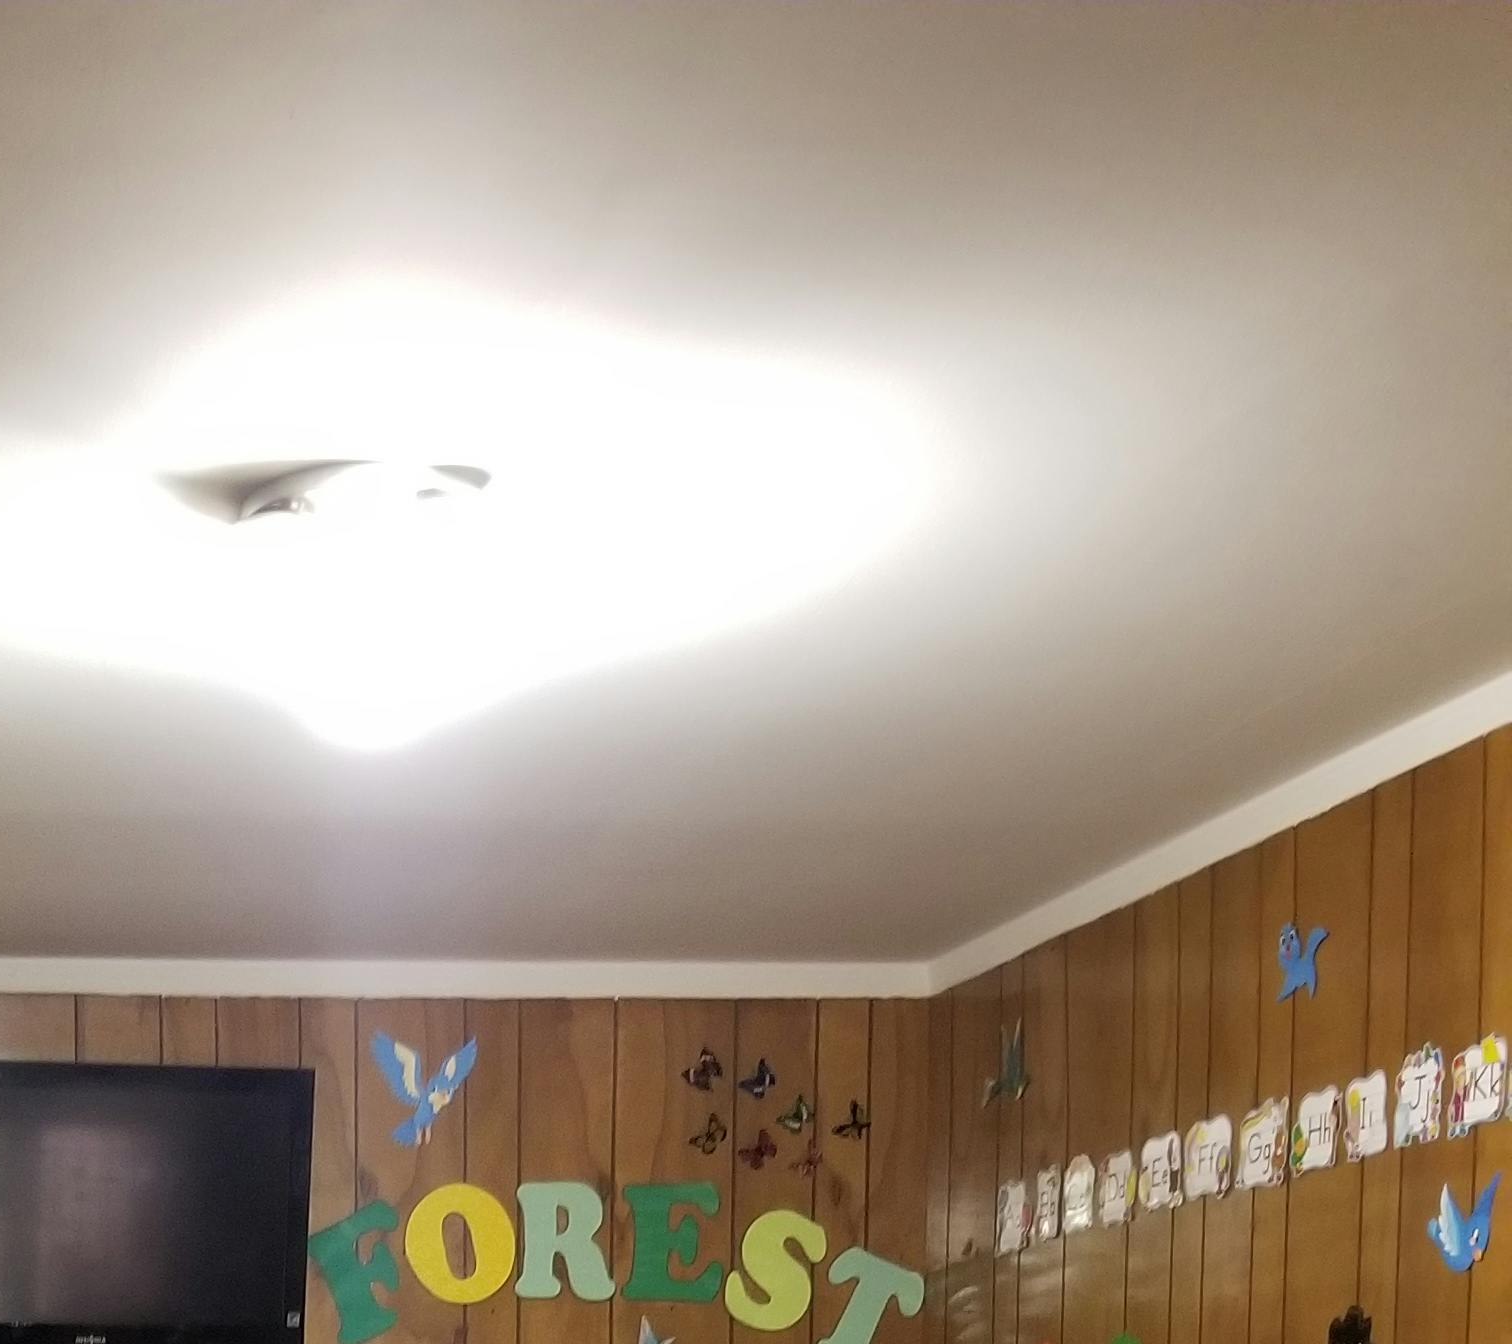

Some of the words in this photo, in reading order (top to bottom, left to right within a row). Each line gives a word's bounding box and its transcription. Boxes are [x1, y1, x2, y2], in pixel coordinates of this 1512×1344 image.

[1107, 1171, 1126, 1201] Dd
[1151, 1156, 1169, 1188] Ee
[1197, 1142, 1218, 1176] Ff
[1247, 1132, 1272, 1175] Gg
[1308, 1112, 1332, 1146] Hh
[1359, 1097, 1373, 1130] Ii
[1408, 1074, 1431, 1124] Jj
[1472, 1063, 1502, 1101] Kk
